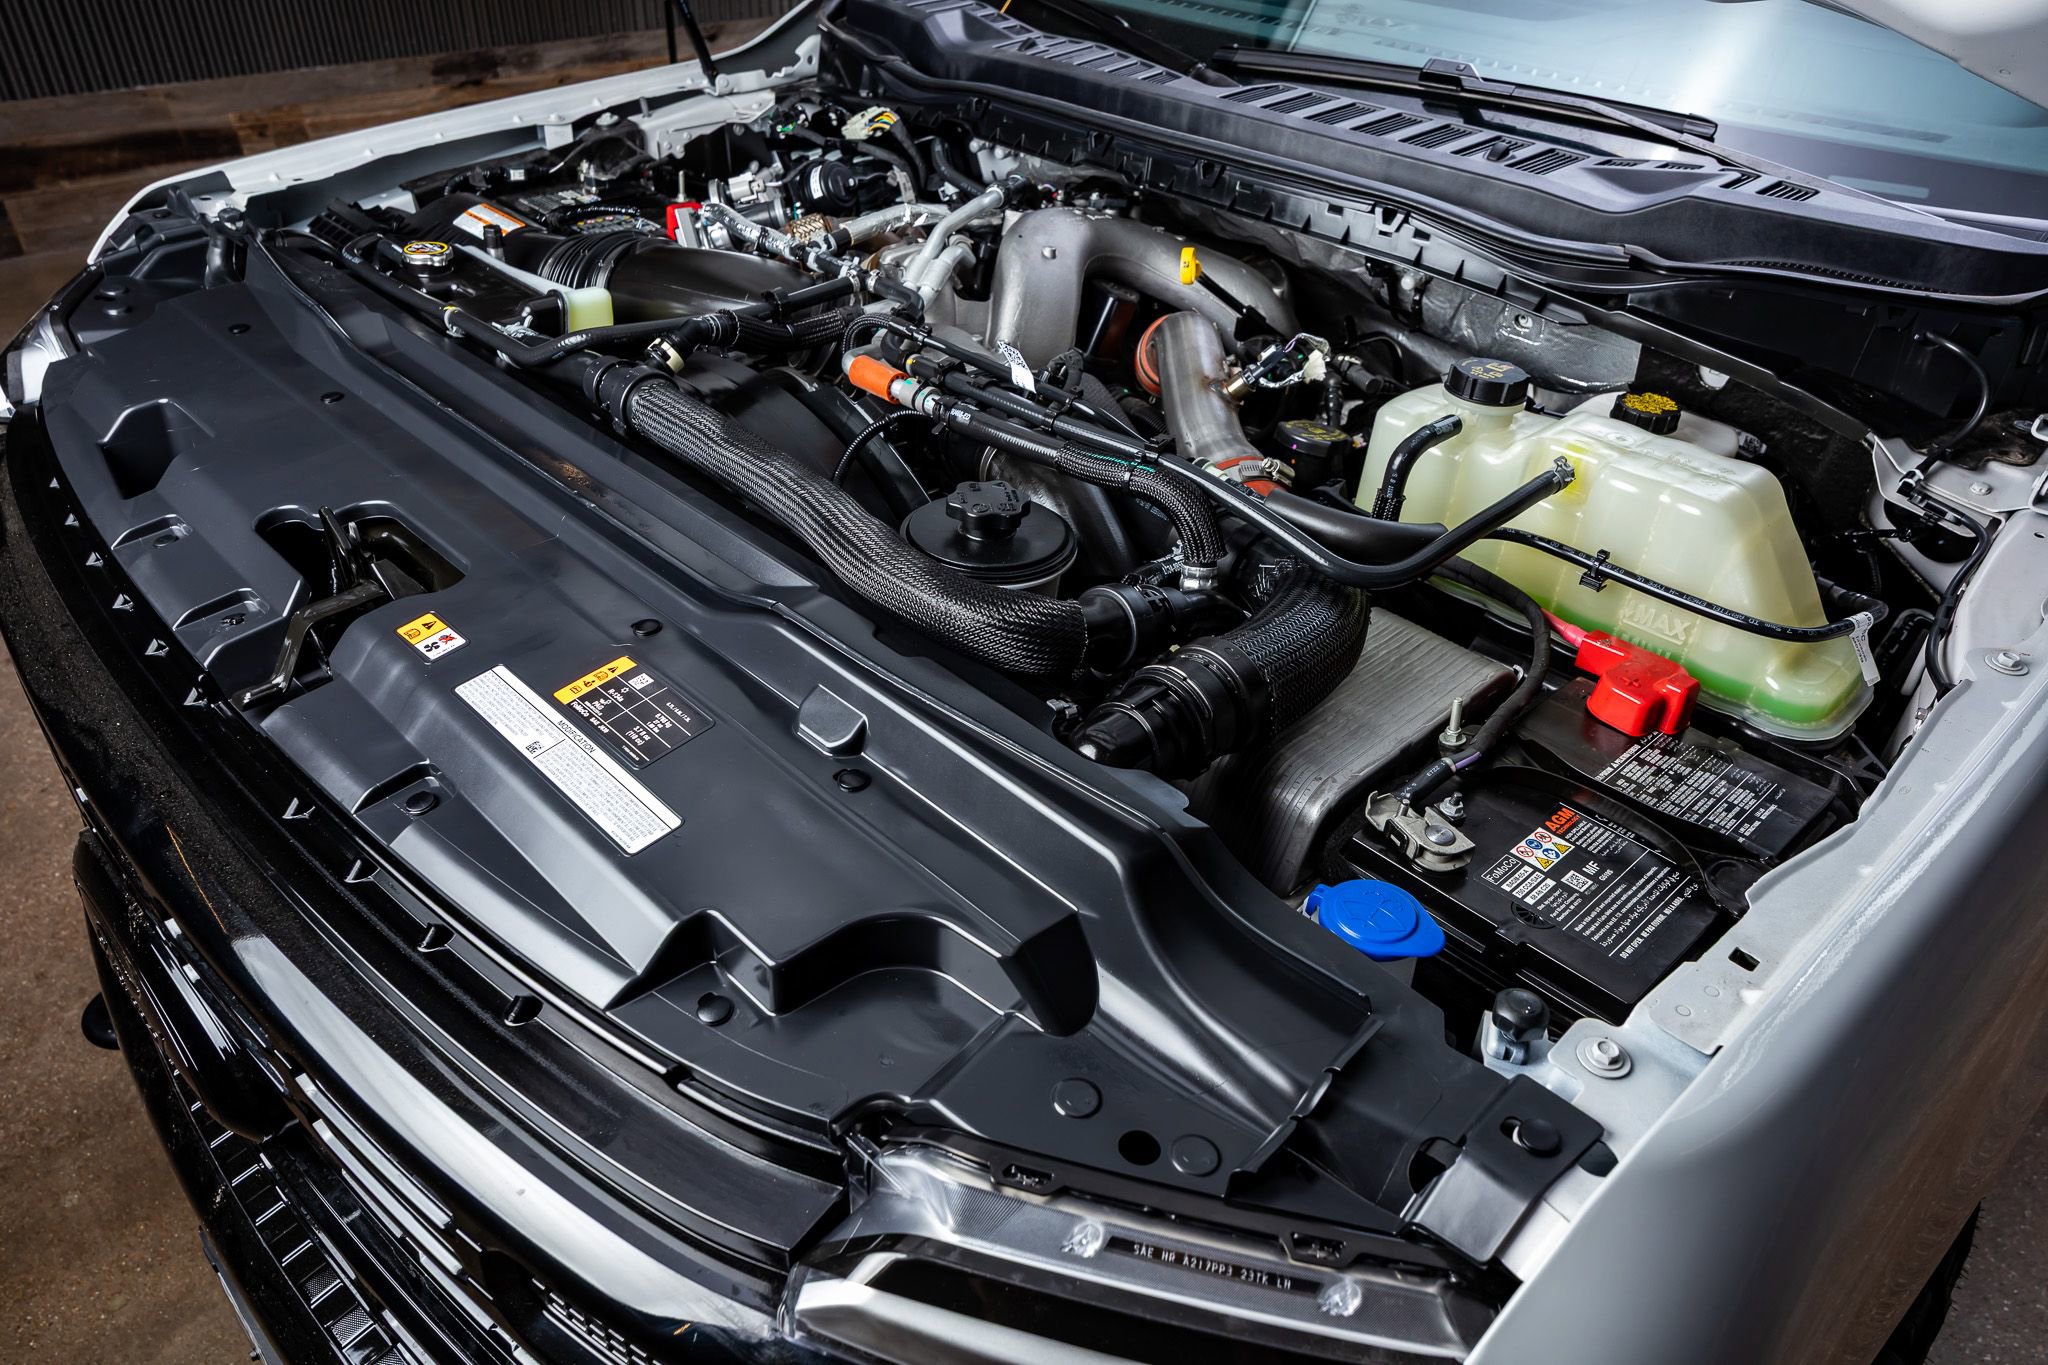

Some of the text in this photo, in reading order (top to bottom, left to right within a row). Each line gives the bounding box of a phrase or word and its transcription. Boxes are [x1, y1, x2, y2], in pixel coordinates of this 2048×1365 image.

[1633, 603, 1690, 641] MAX
[569, 701, 590, 717] FoMoCo
[557, 720, 597, 753] MODIFICATION
[1543, 806, 1575, 831] AGM
[1556, 814, 1581, 835] TECHNOLOGY
[1486, 857, 1517, 881] FoMoCo
[1582, 859, 1602, 875] MF
[1134, 1244, 1154, 1257] SAE
[1161, 1251, 1176, 1263] HR
[1276, 1276, 1292, 1290] LH
